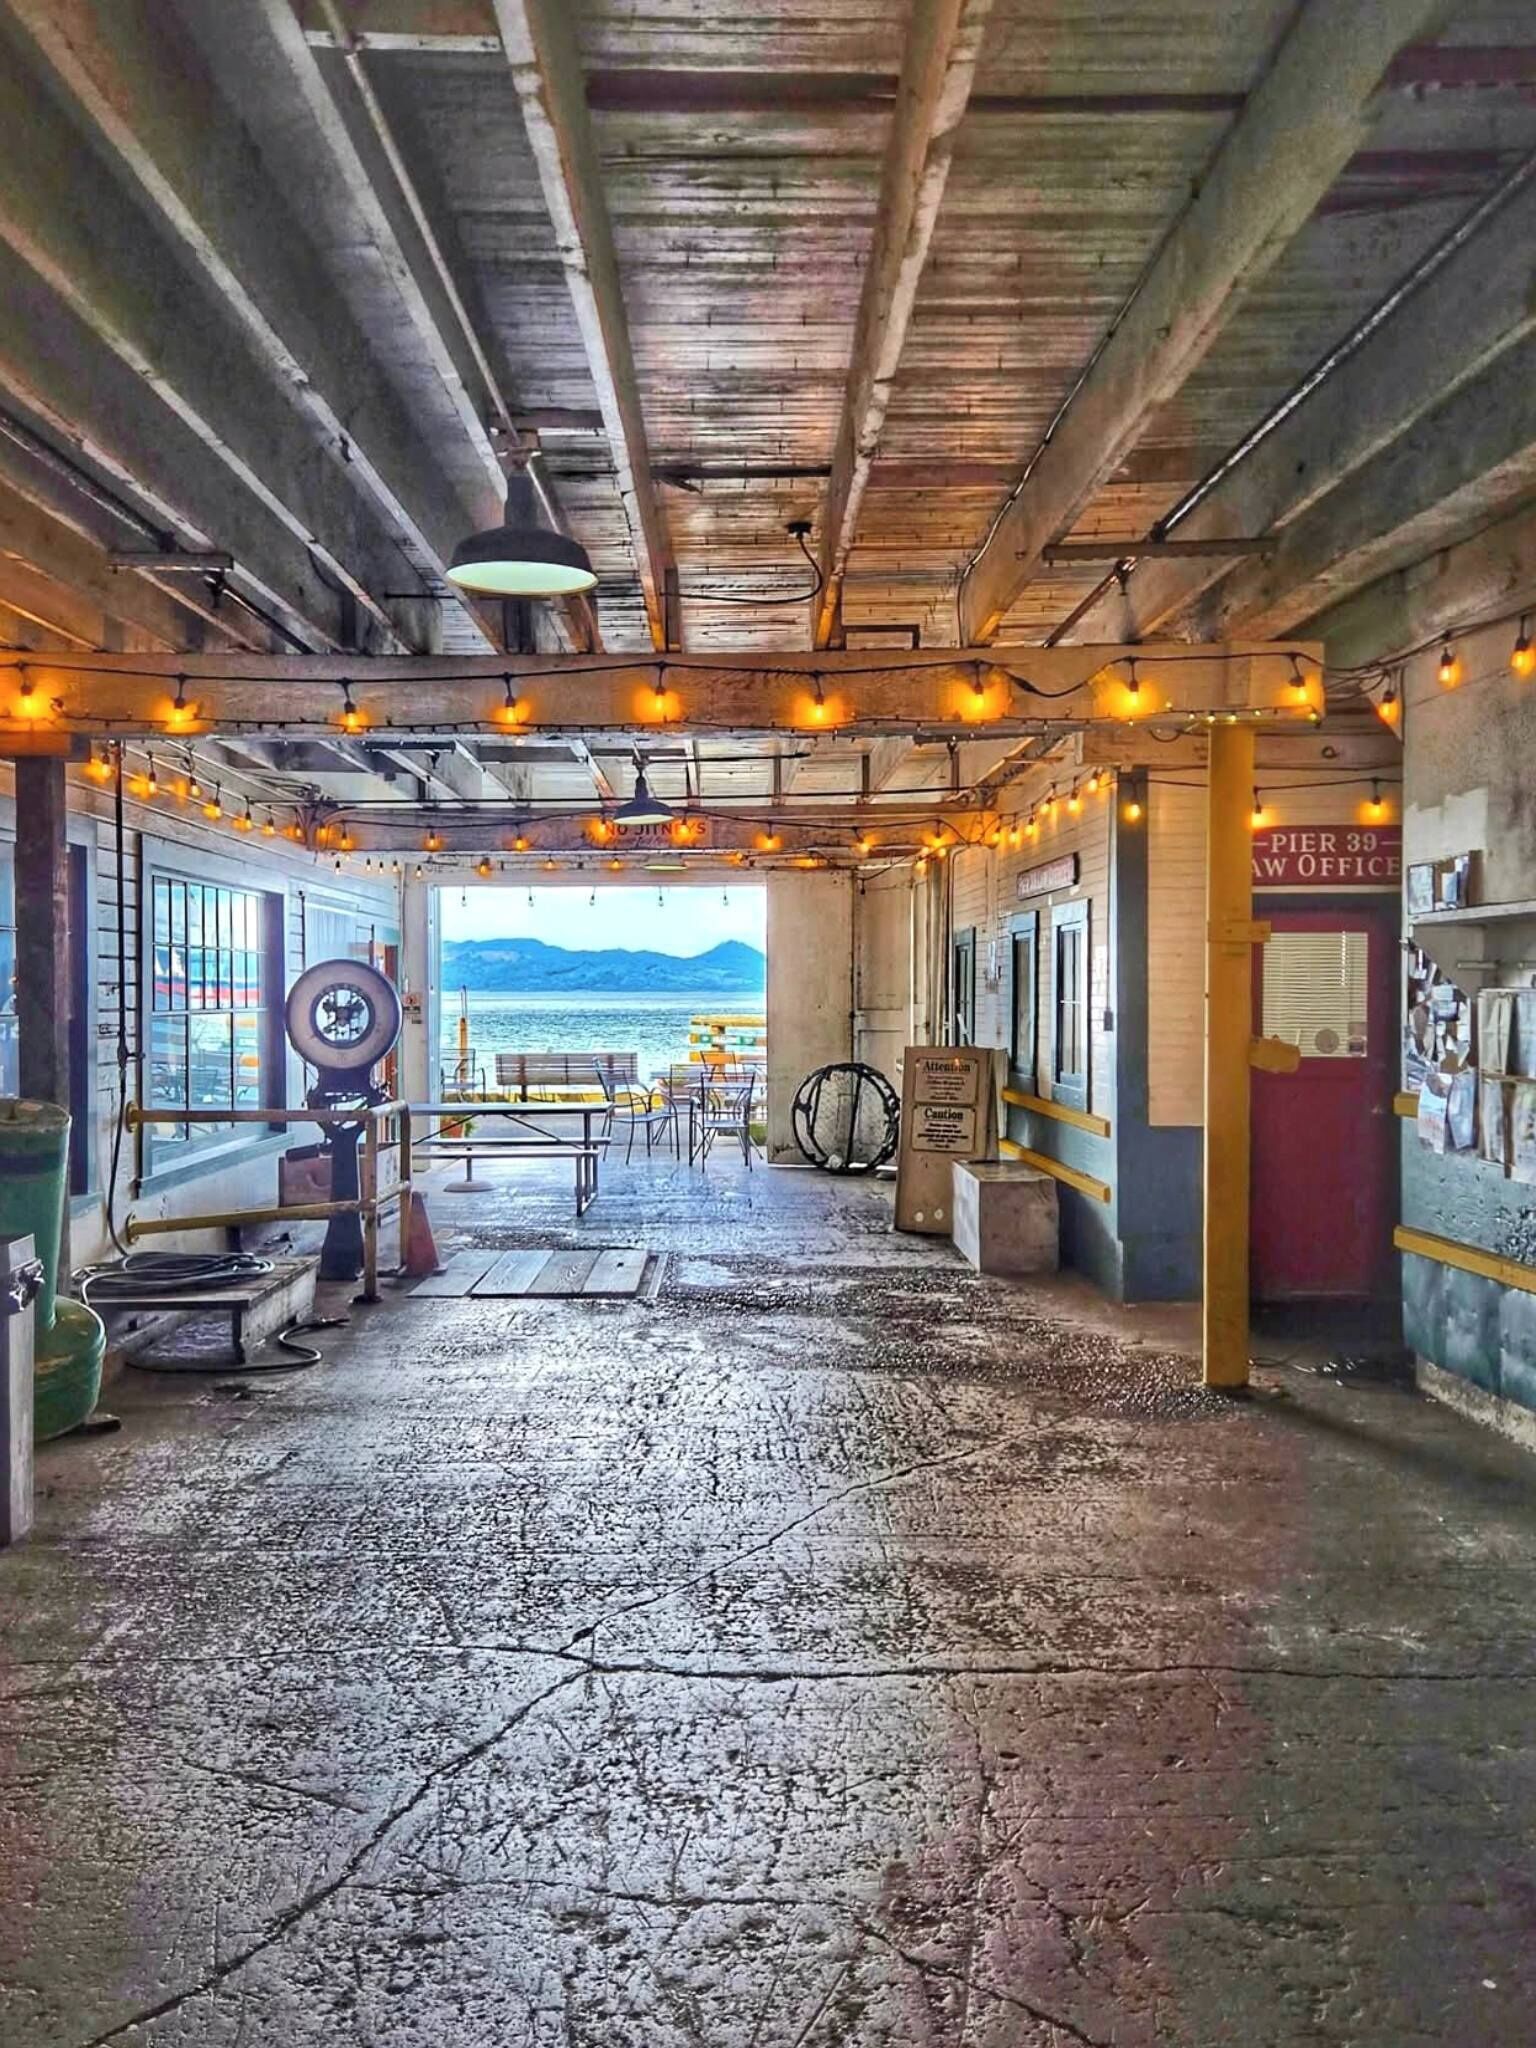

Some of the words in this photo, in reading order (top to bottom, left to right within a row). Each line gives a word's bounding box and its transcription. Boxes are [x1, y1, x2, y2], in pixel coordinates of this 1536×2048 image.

[1270, 833, 1337, 853] PIER
[1346, 832, 1378, 852] 39
[1251, 857, 1289, 877] AW
[1297, 853, 1401, 877] OFFICE
[922, 1060, 971, 1072] Attention
[924, 1106, 964, 1120] Caution
